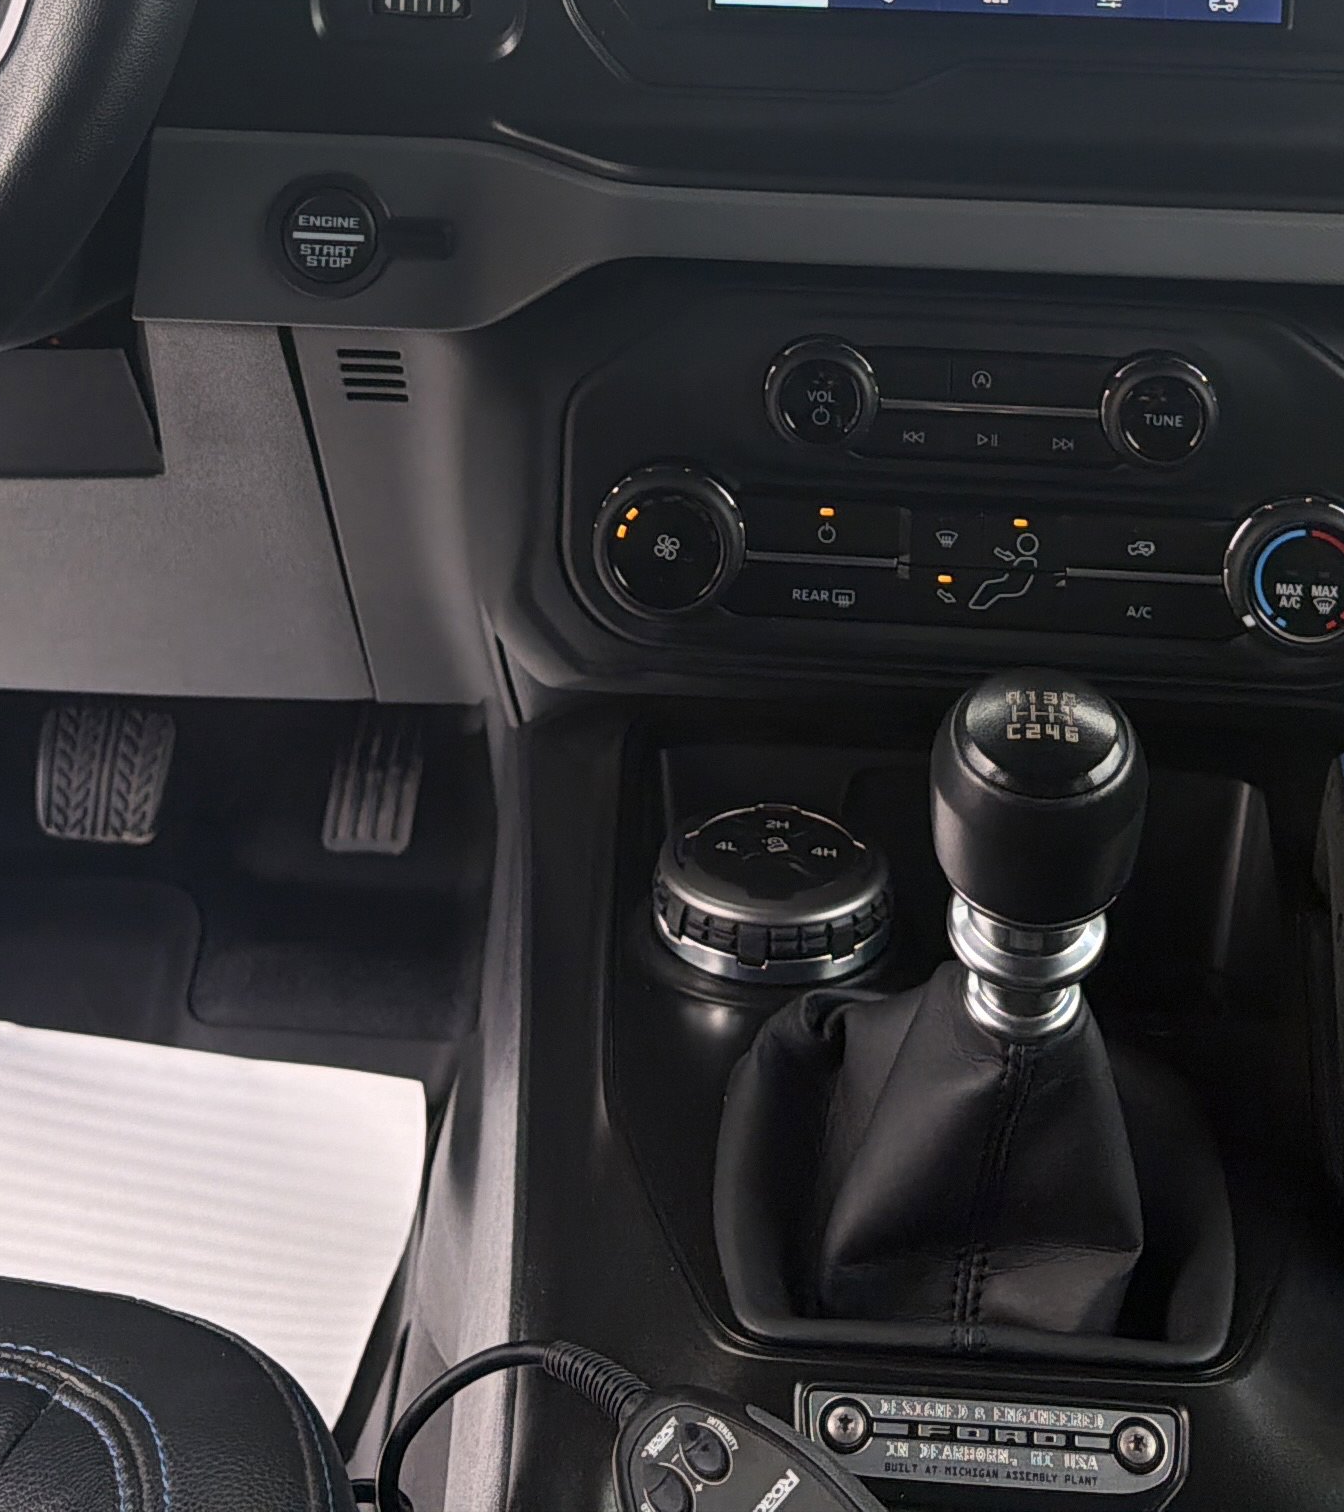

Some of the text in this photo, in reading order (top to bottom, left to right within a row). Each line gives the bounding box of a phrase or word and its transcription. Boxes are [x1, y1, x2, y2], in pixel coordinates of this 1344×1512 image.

[298, 214, 361, 230] ENGINE
[299, 244, 358, 257] START
[306, 256, 353, 269] STOP
[807, 390, 836, 403] VOL
[1143, 413, 1185, 428] TUNE
[792, 588, 830, 602] REAR
[1275, 582, 1303, 596] MAX
[1311, 584, 1339, 599] MAX
[1279, 596, 1302, 610] A/C
[1126, 606, 1153, 620] A/C
[1007, 723, 1079, 743] C 2 4 6
[765, 819, 790, 830] 2H
[715, 840, 737, 852] 4L
[810, 847, 838, 858] 4H
[880, 1399, 1105, 1429] DESIGNED & ENGINEERED
[707, 1416, 739, 1451] INTENSITY
[918, 1423, 1066, 1447] FORD
[886, 1441, 1099, 1470] IN DEARBORN, MI USA
[884, 1462, 1098, 1487] BUILT AT MICHIGAN ASSEMBLY PLANT
